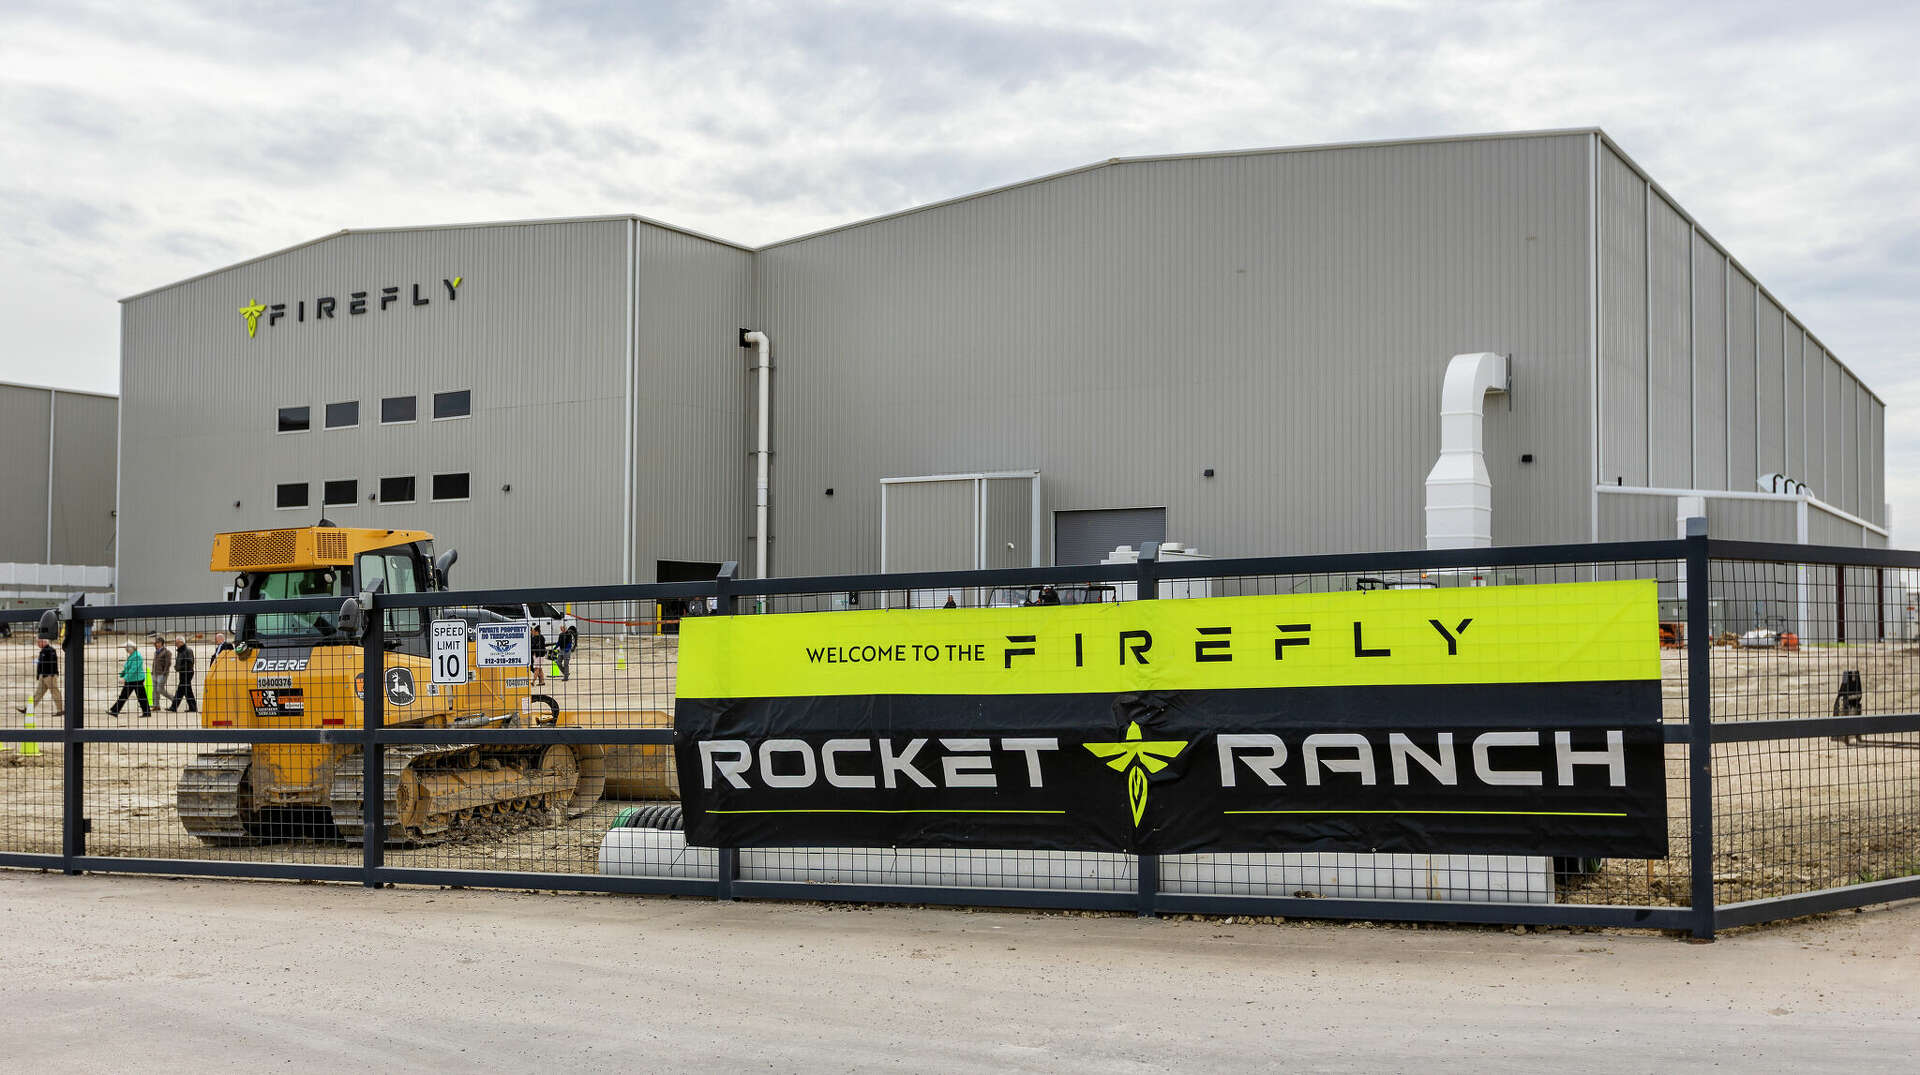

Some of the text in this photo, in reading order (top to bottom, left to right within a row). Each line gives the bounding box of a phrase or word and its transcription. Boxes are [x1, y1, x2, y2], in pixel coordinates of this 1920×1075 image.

[269, 276, 463, 326] FIREFLY
[434, 627, 464, 637] SPEED
[806, 617, 1474, 669] WELCOME TO THE FIREFLY
[437, 640, 461, 650] LIMIT
[252, 658, 309, 672] DEERE
[438, 654, 460, 678] 10
[698, 730, 1627, 790] ROCKET RANCH
